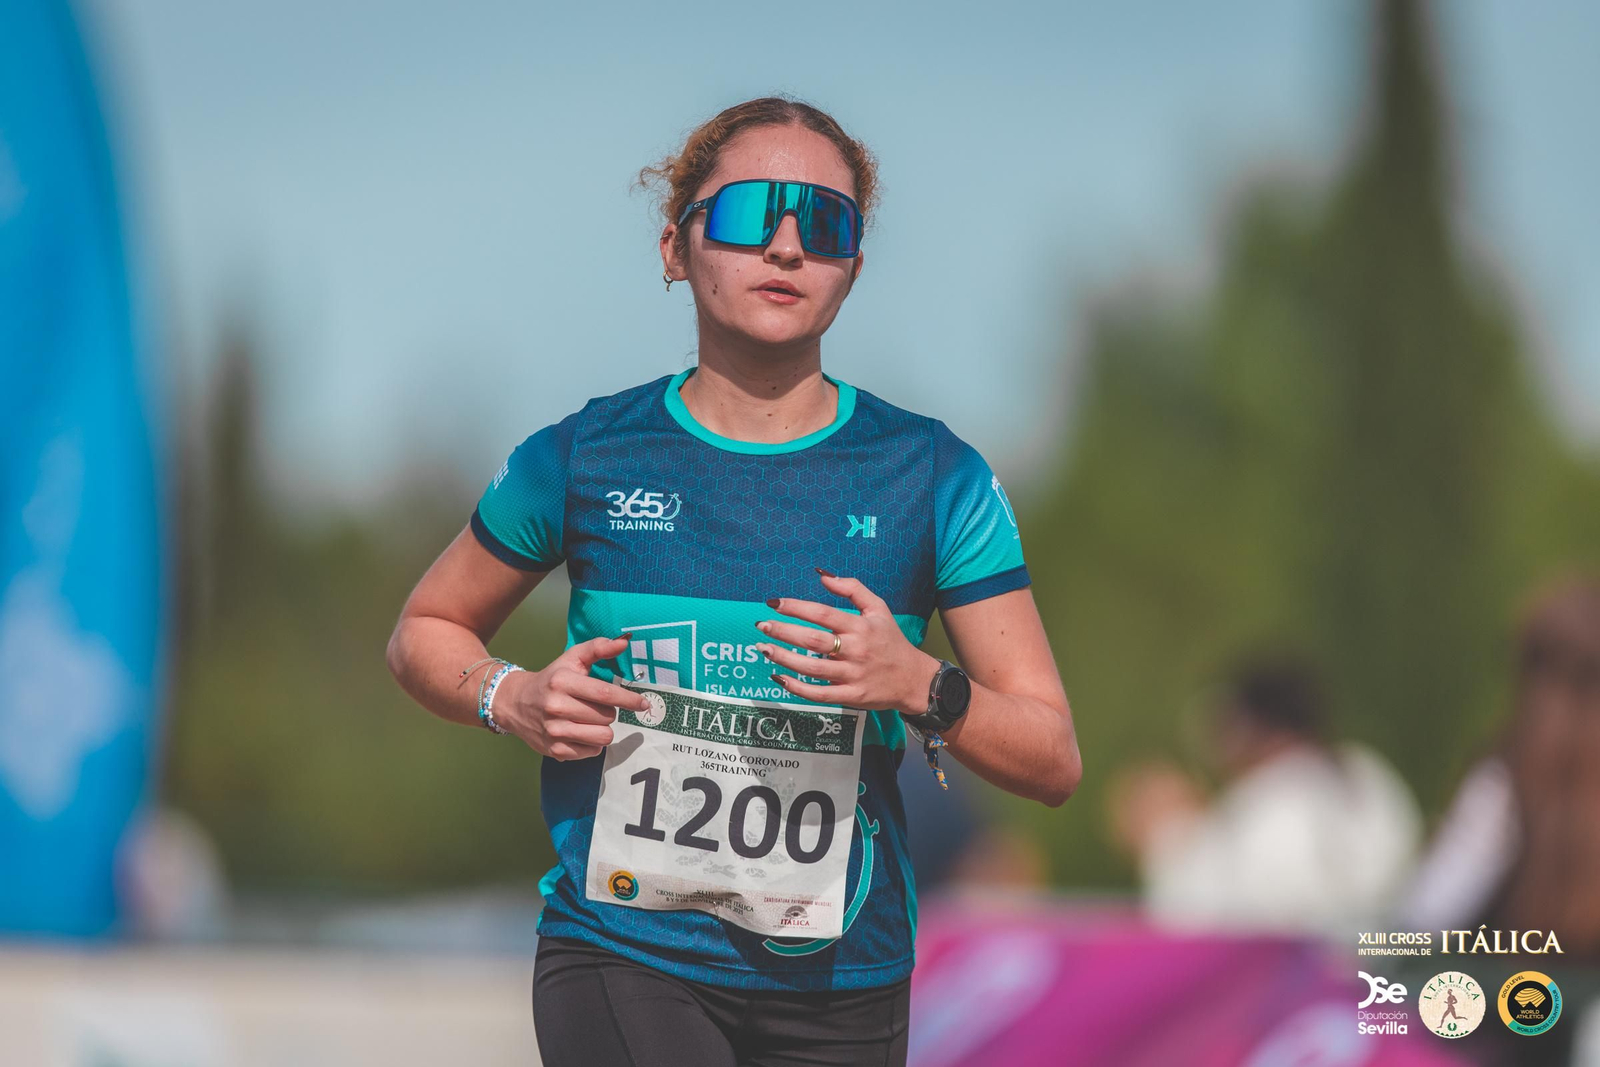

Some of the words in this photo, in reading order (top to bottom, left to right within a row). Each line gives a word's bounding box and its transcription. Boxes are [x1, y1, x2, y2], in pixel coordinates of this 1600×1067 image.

[605, 488, 664, 518] 365
[609, 520, 675, 532] TRAINING
[704, 663, 755, 679] FCO.
[705, 683, 738, 697] ISLA
[740, 686, 791, 699] MAYOR
[682, 704, 798, 742] ITÁLICA
[680, 728, 735, 744] INTERNATIONAL
[739, 738, 760, 746] CROSS
[763, 740, 797, 749] COUNTRY
[815, 742, 841, 752] Sevilla
[672, 743, 693, 755] RUT
[694, 746, 737, 763] LOZANO
[740, 754, 799, 769] CORONADO
[700, 760, 767, 778] 365TRAINING
[624, 767, 836, 864] 1200
[656, 889, 675, 898] CROSS
[780, 918, 810, 926] ITÁLICA
